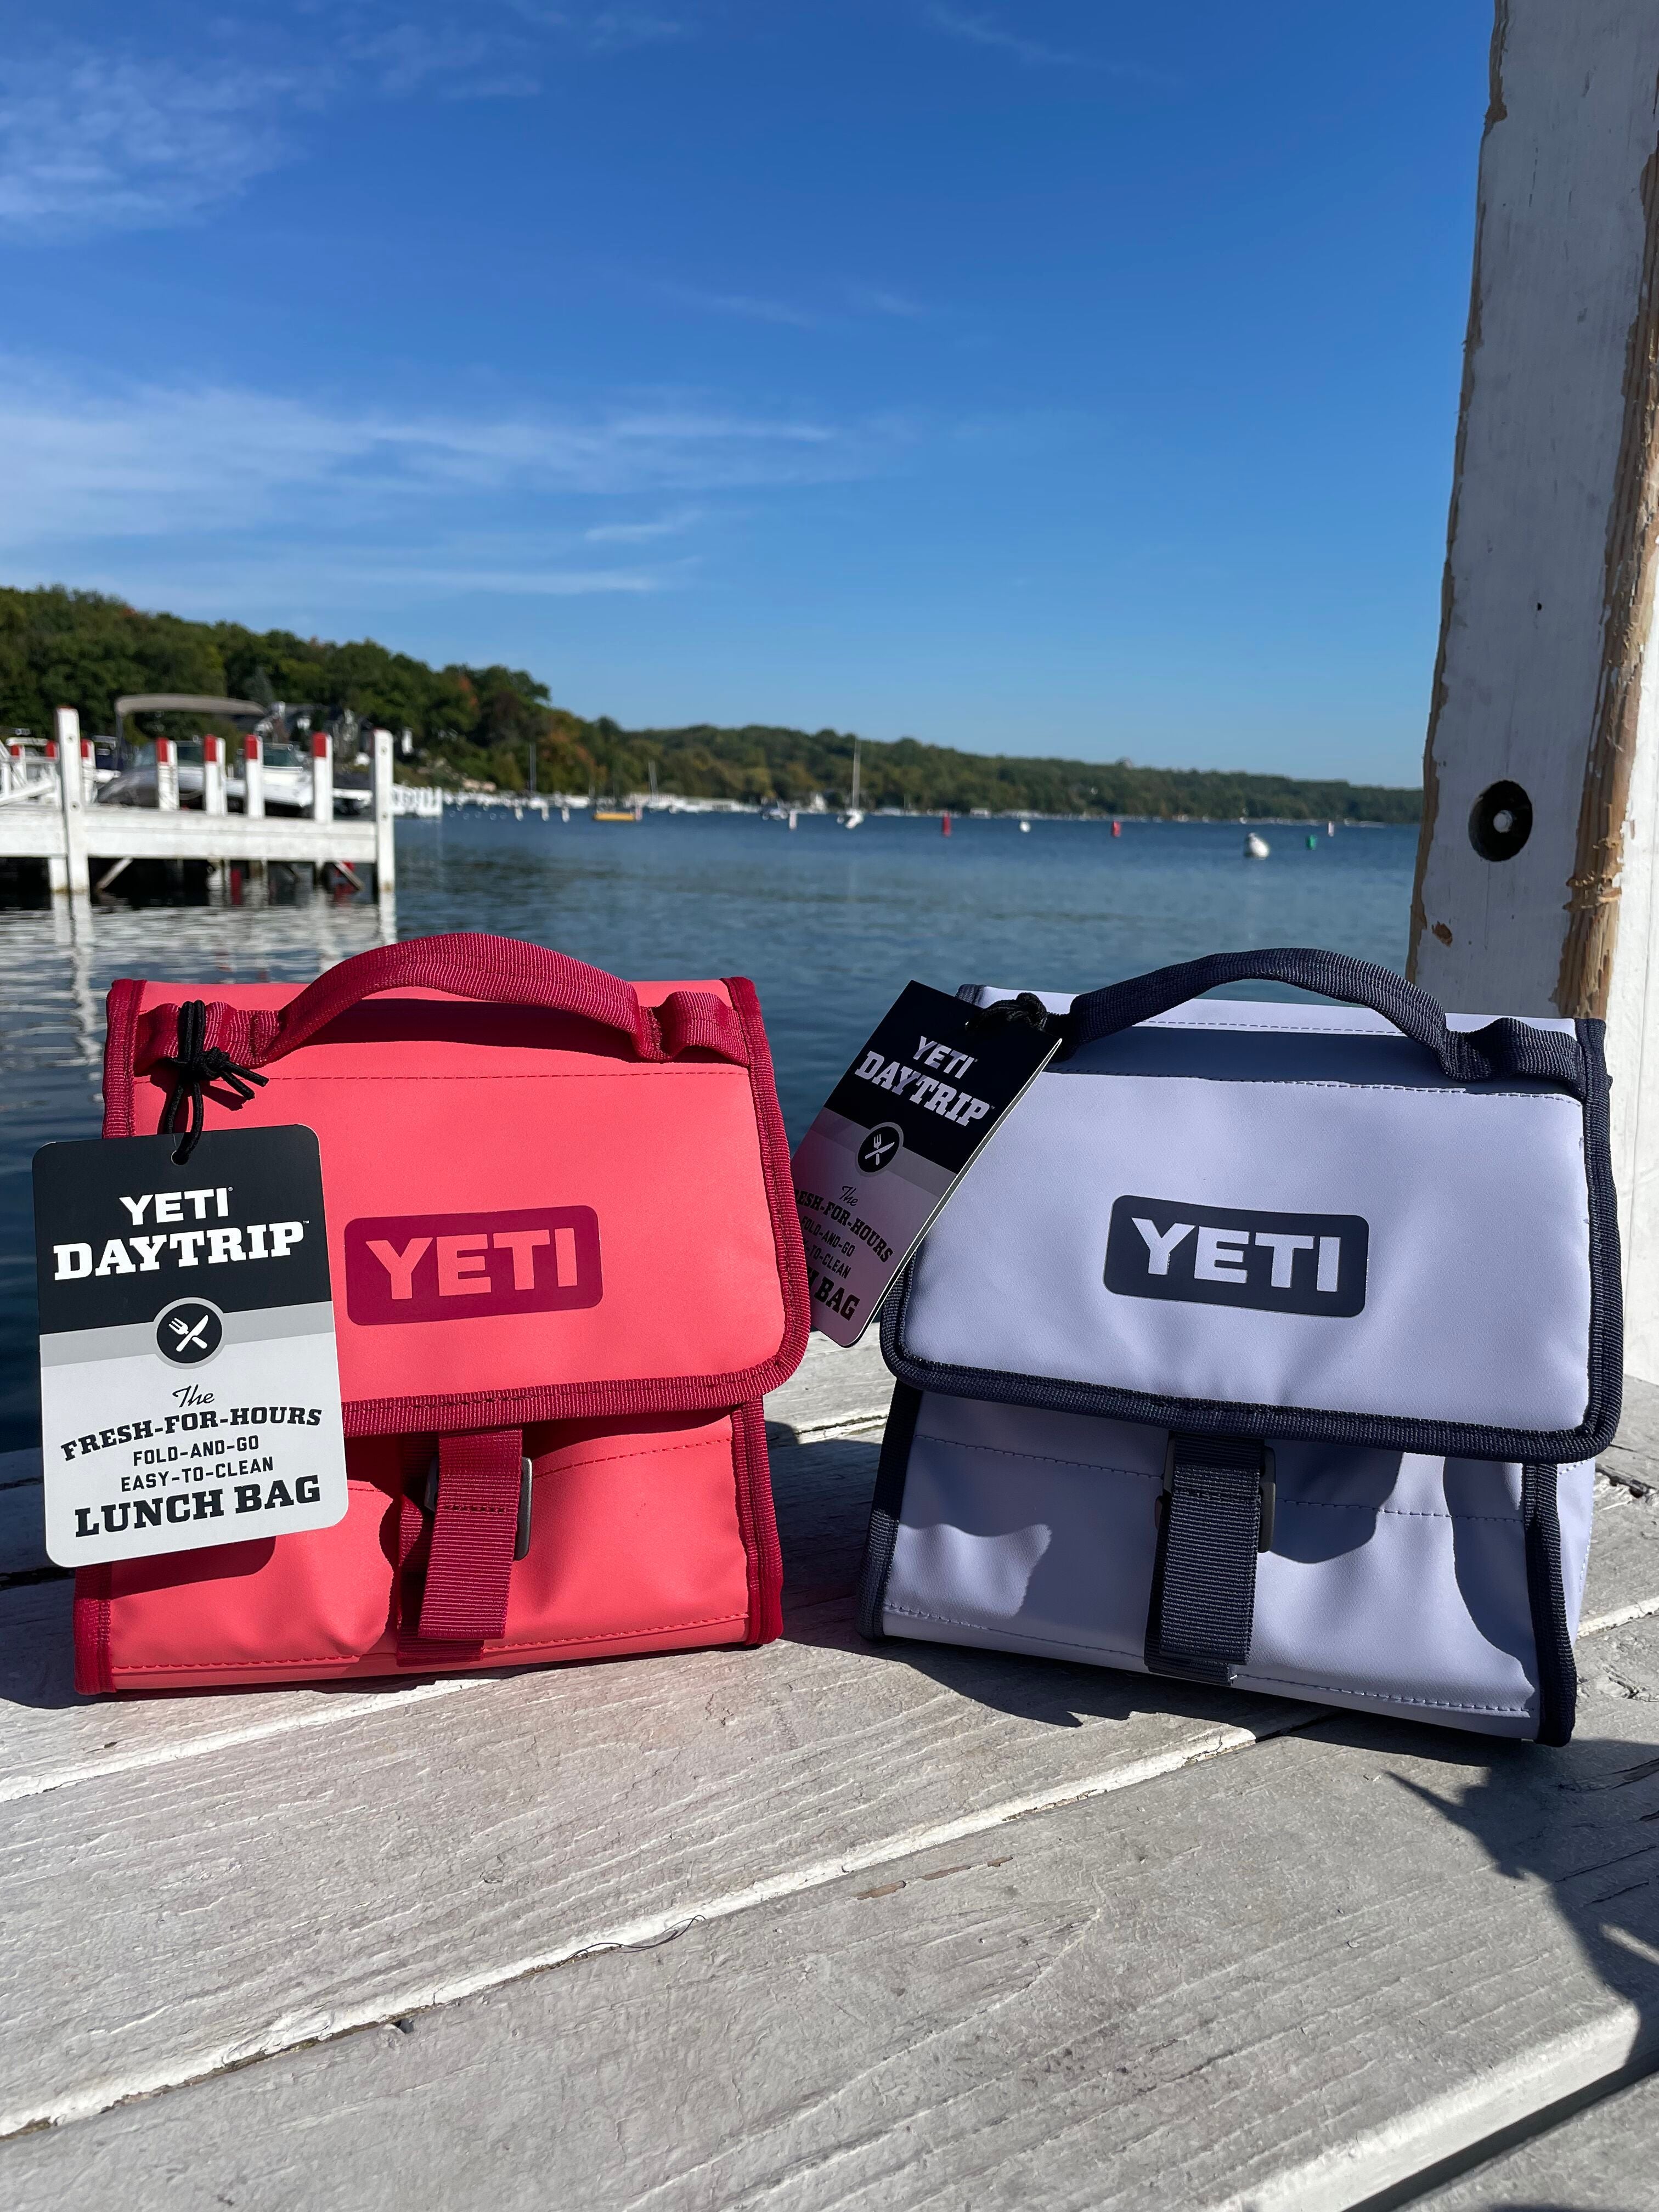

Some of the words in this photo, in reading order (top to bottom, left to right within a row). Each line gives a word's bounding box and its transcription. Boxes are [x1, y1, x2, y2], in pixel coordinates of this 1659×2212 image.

[912, 1035, 975, 1079] YETI
[119, 1187, 229, 1226] YETI
[839, 1185, 859, 1206] The
[795, 1189, 894, 1263] ESH-FOR-HOURS
[800, 1215, 856, 1257] FOLD-AND-GO
[365, 1227, 578, 1300] YETI
[1131, 1217, 1341, 1293] YETI
[814, 1276, 860, 1322] BAG
[172, 1384, 216, 1408] The
[60, 1406, 322, 1462] FRESH-FOR-HOURS
[133, 1435, 259, 1466] FOLD-AND-GO
[121, 1456, 274, 1492] EASY-TO-CLEAN
[74, 1488, 224, 1538] LUNCH
[234, 1474, 321, 1514] BAG
